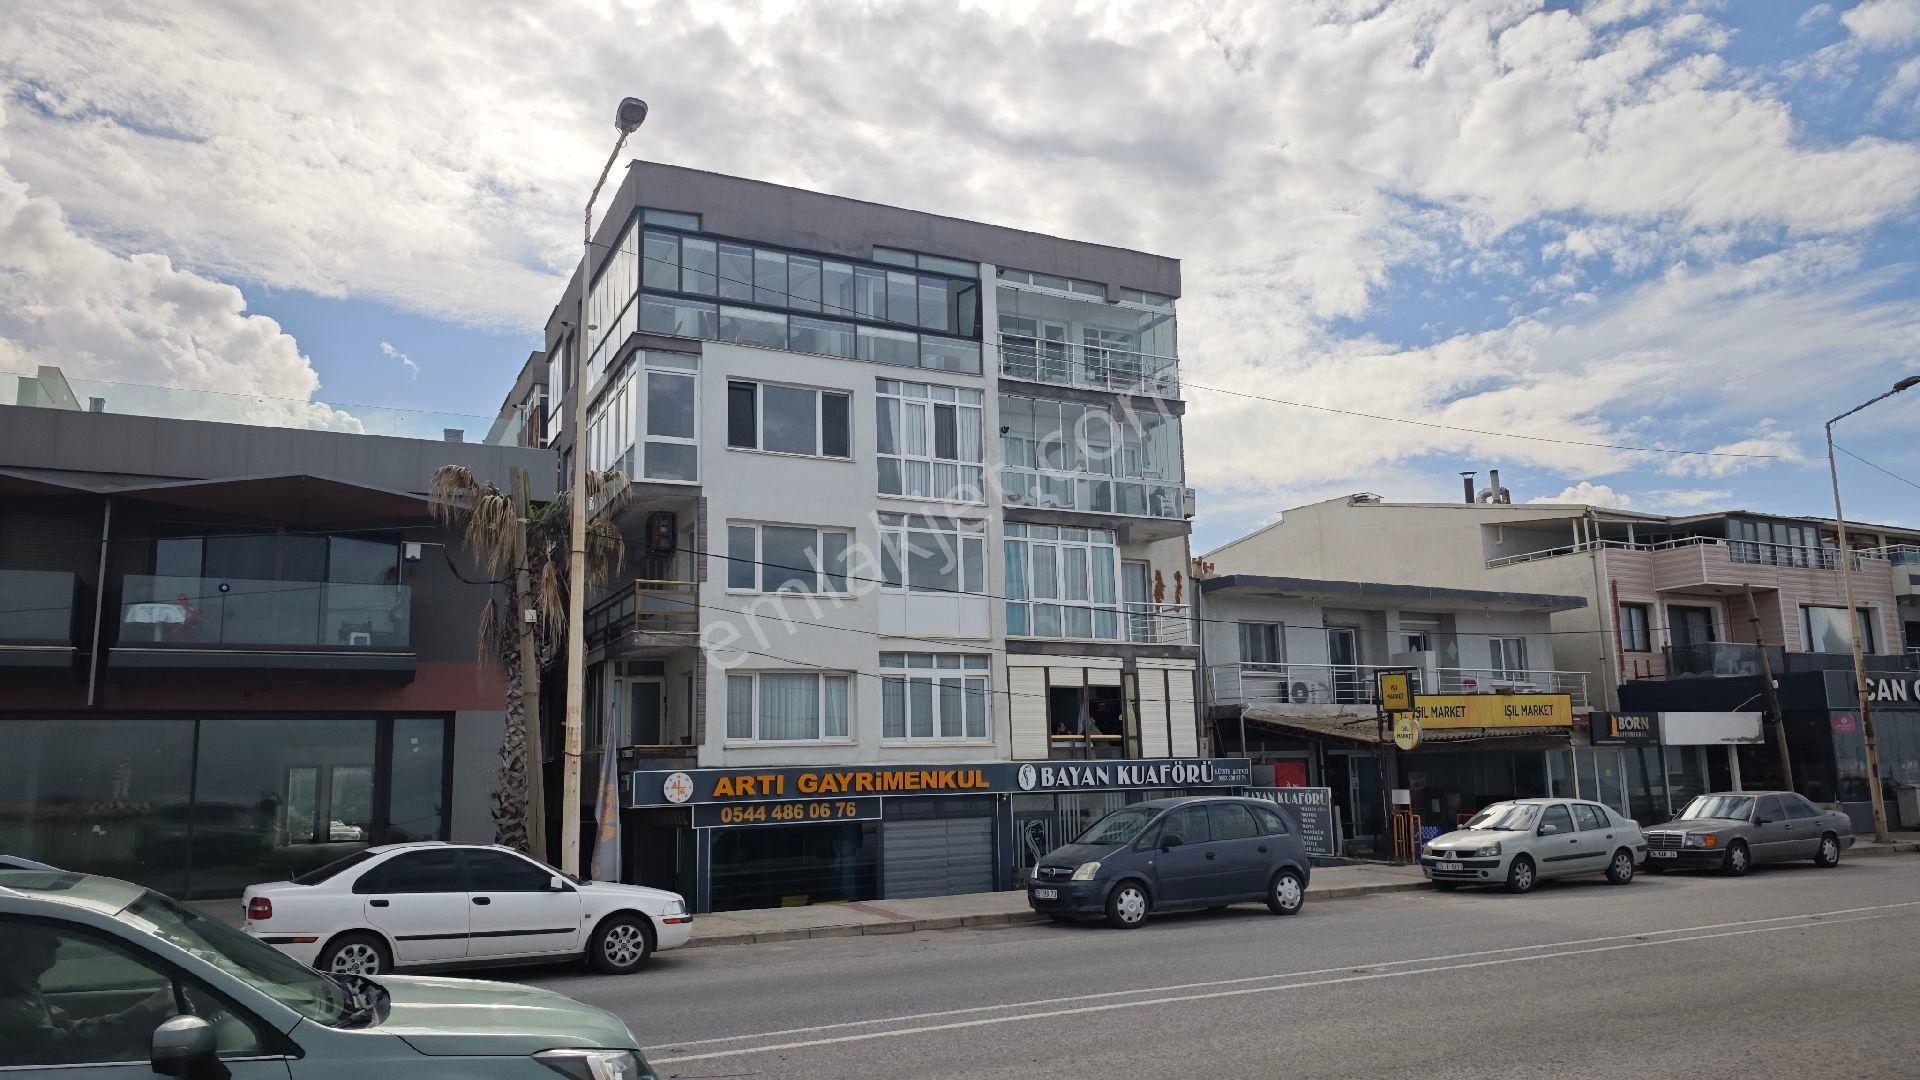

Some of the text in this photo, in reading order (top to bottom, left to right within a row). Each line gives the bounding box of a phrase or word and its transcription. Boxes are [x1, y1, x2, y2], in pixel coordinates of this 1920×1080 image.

[1866, 678, 1907, 701] CAN
[1431, 705, 1466, 718] MARKET
[1505, 705, 1554, 720] IŞIL MARKET
[1618, 716, 1649, 730] BORN
[1040, 760, 1214, 787] BAYAN KUAFÖRÜ
[712, 774, 784, 797] ARTI
[1277, 790, 1328, 805] KUAFÖRÜ
[720, 801, 856, 823] 0544 486 06 76
